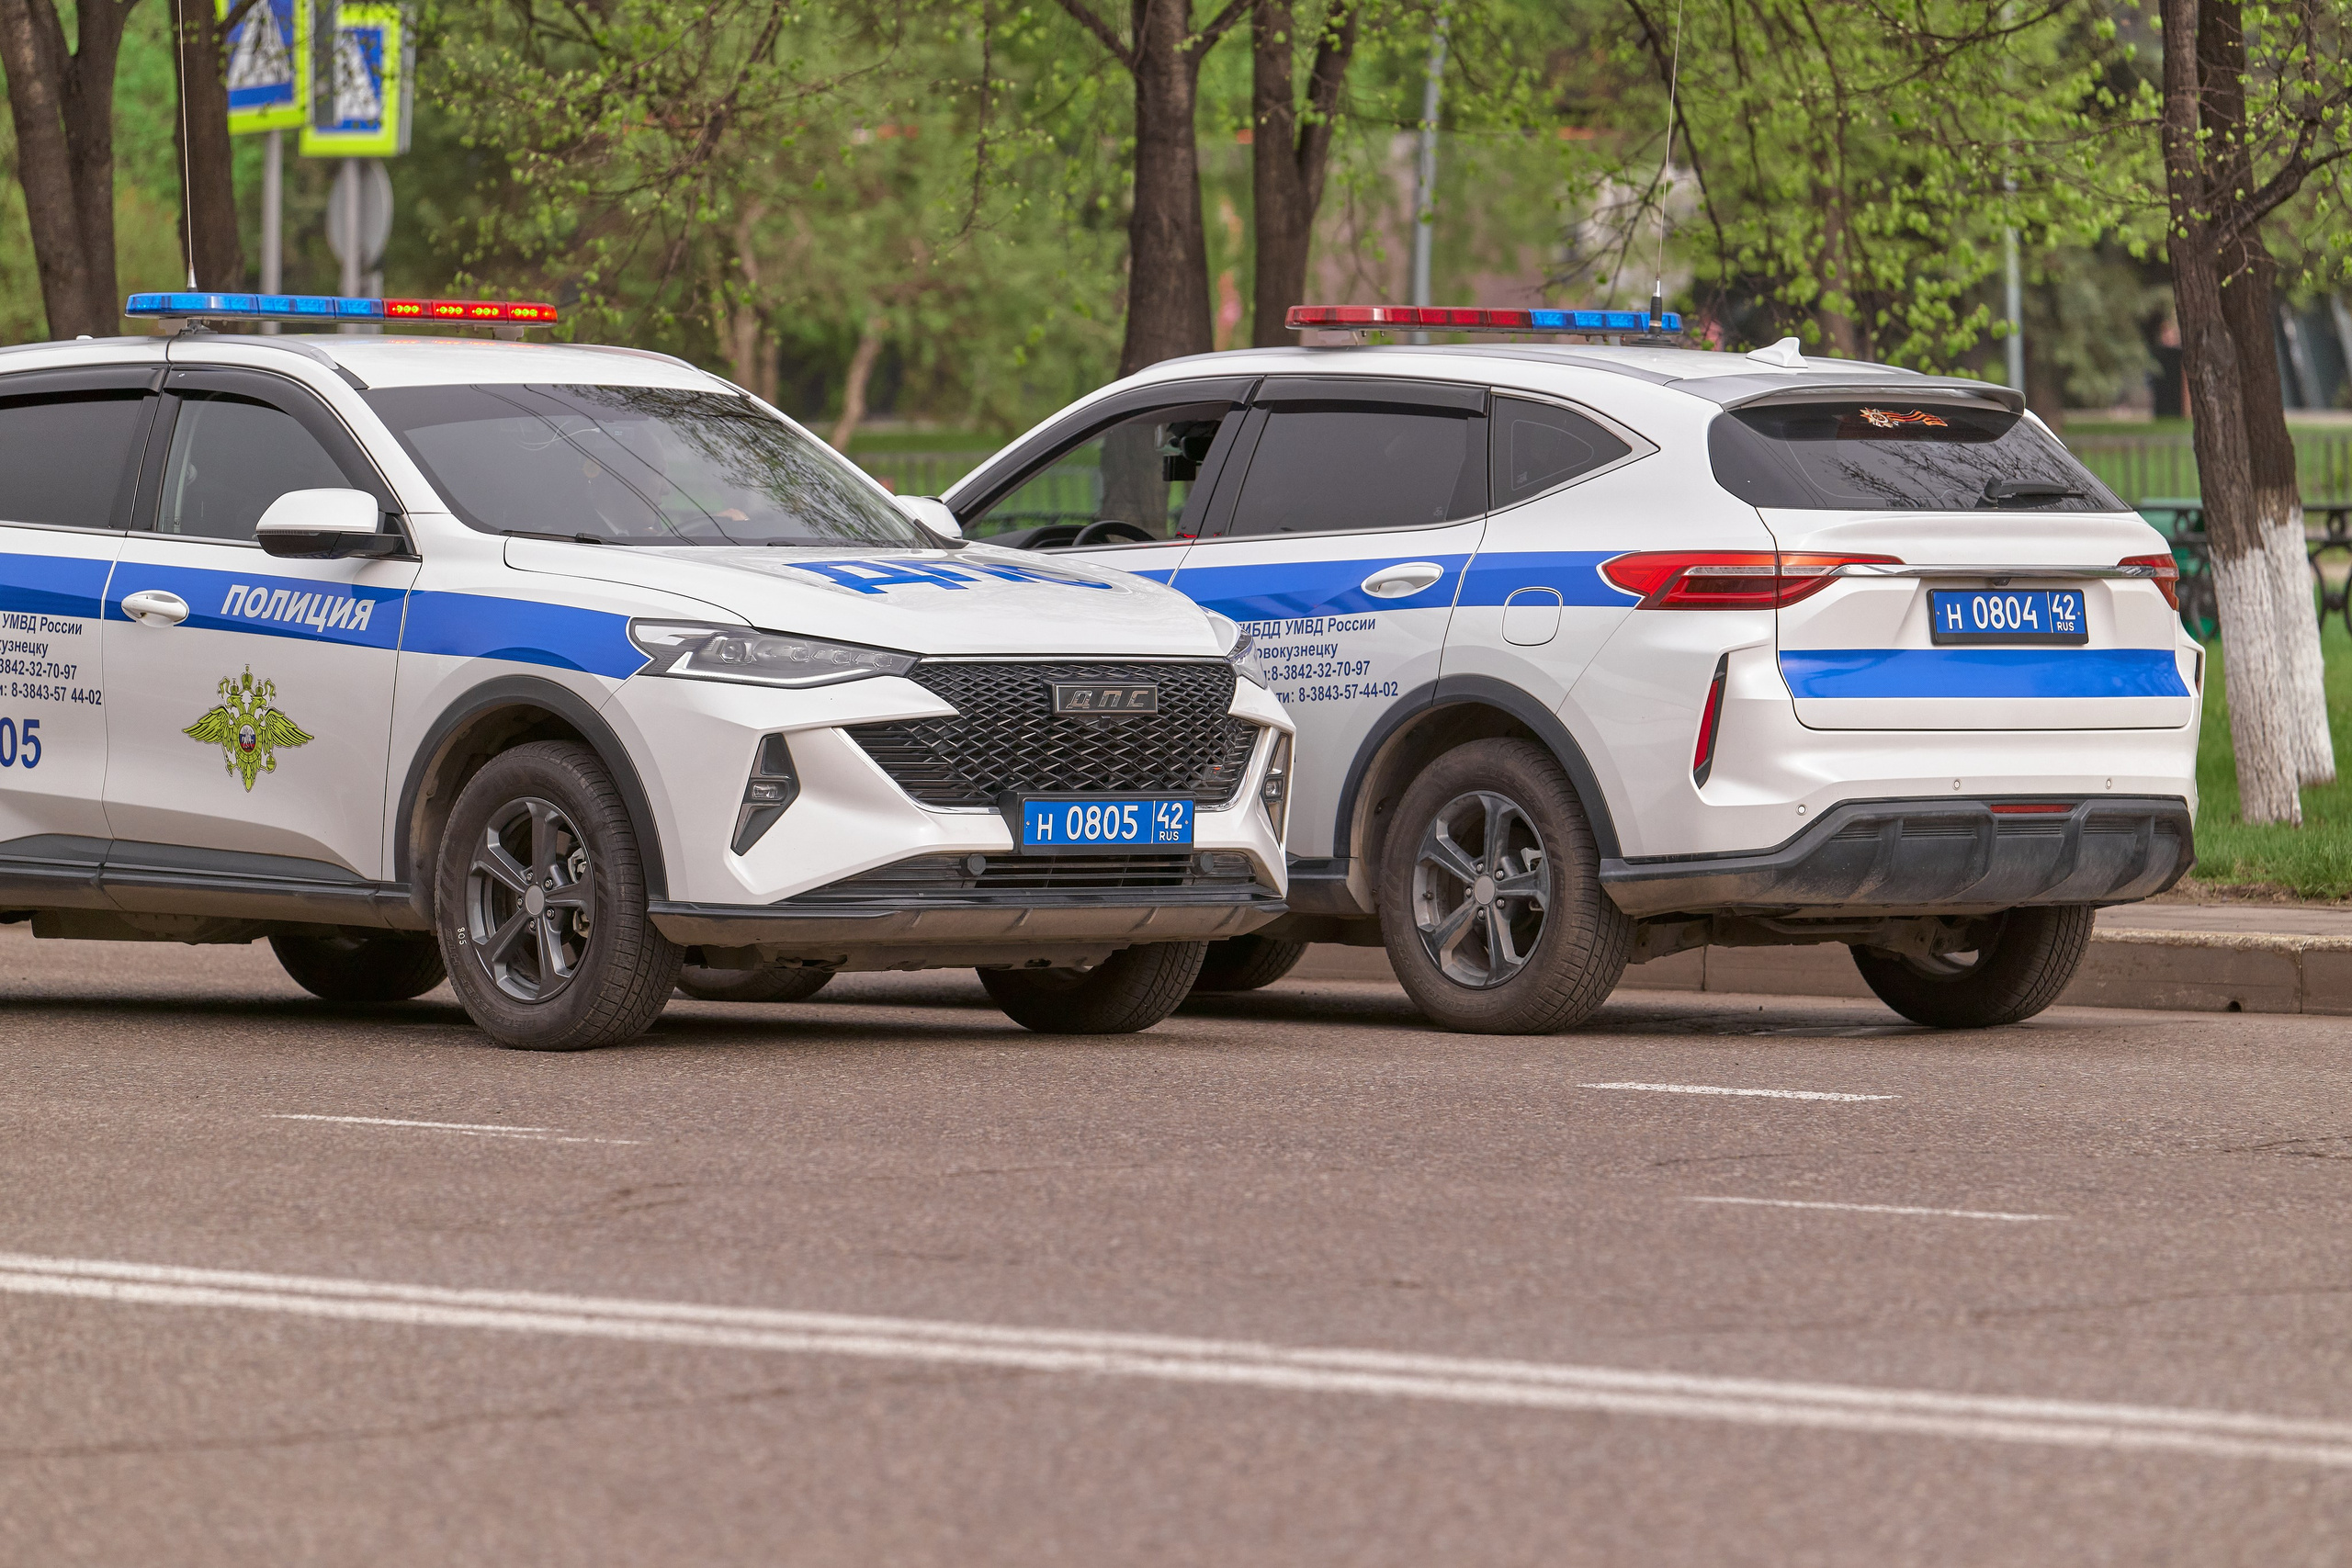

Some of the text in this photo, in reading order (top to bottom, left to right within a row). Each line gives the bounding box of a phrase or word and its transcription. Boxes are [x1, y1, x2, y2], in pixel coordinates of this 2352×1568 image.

[781, 560, 1113, 594] ДПС
[220, 584, 376, 633] ПОЛИЦИЯ
[1973, 595, 2039, 630] 0804
[2052, 594, 2076, 620] 42
[2, 613, 83, 636] УМВД России
[1239, 617, 1376, 639] ИБДД УМВД России
[2056, 621, 2075, 632] RUS
[11, 682, 67, 702] 8-3843-57
[71, 688, 102, 705] 44-02
[1066, 690, 1149, 709] ДПС
[1298, 682, 1398, 702] 8-3843-57-44-02
[0, 716, 42, 769] 05
[1066, 805, 1139, 840] 0805
[1157, 802, 1184, 829] 42
[1159, 830, 1180, 841] RUS
[458, 927, 467, 945] 805
